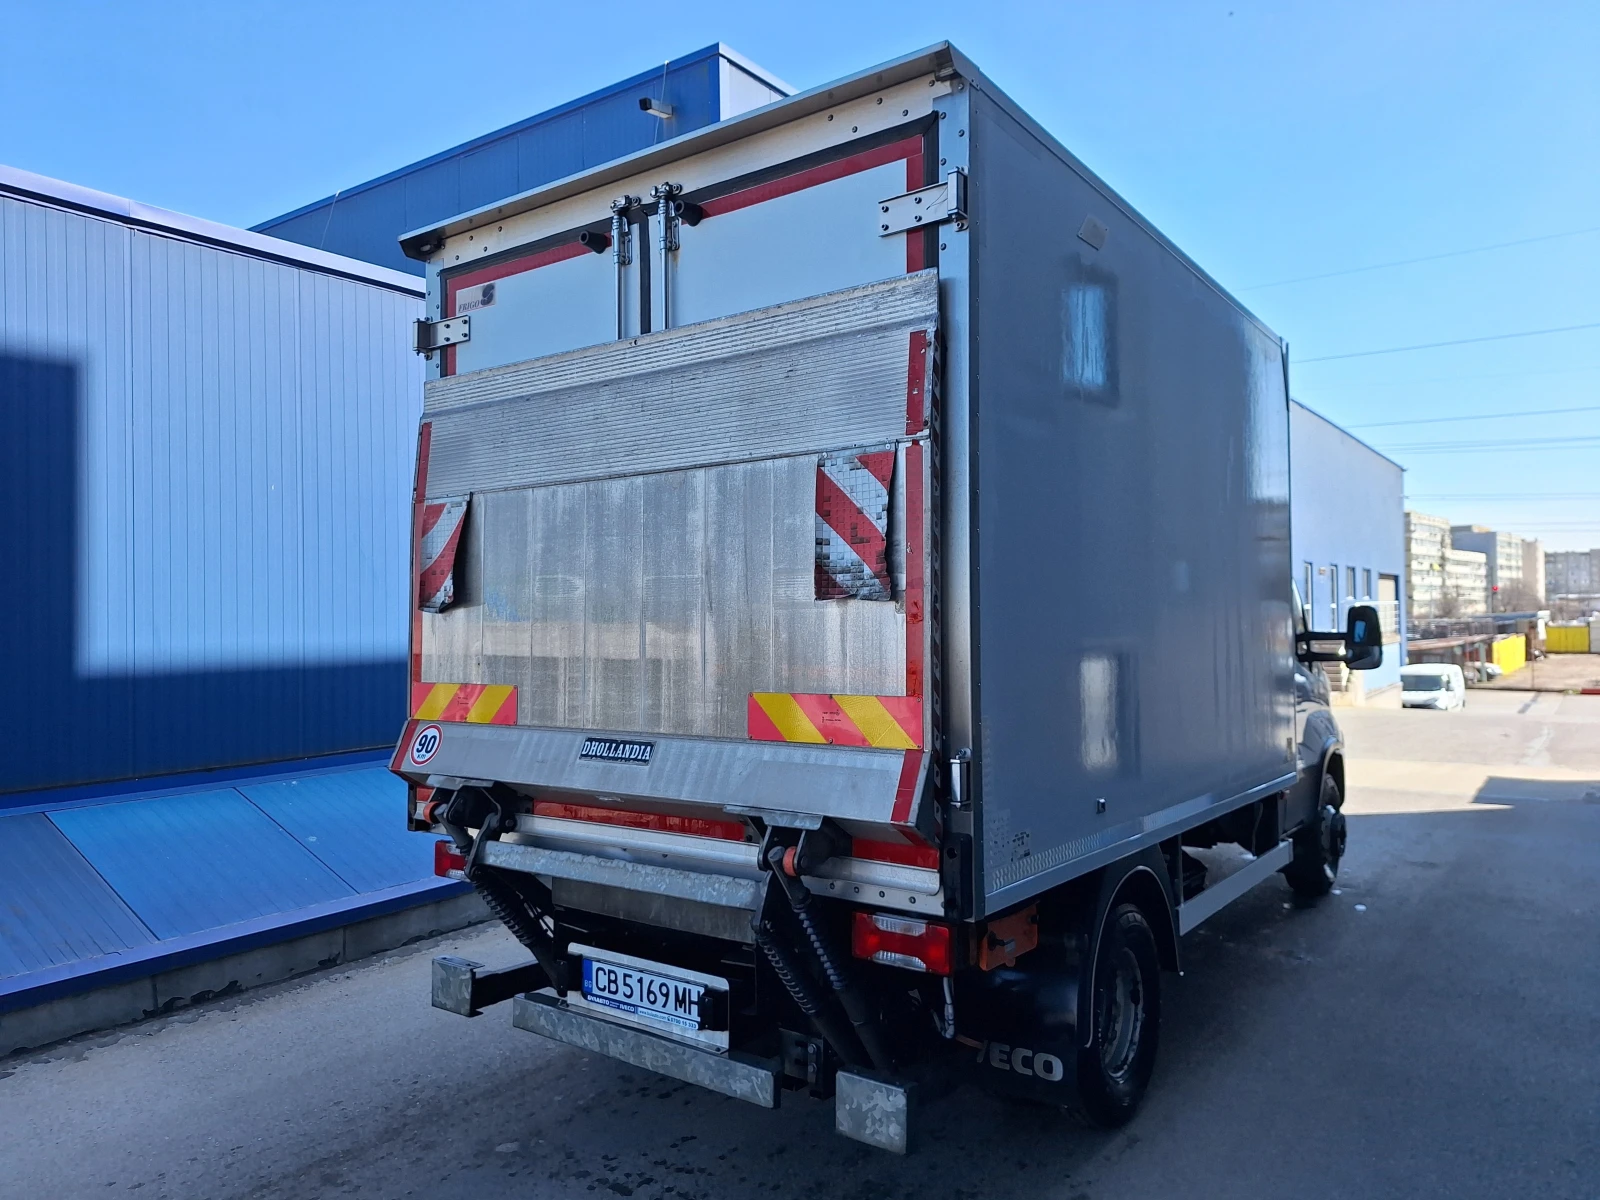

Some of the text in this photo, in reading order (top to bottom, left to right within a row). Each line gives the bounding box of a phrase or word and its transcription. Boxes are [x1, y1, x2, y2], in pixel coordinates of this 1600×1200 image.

[416, 734, 437, 754] 90
[581, 740, 651, 760] DHOLLANDIA
[619, 1003, 635, 1012] IVECO
